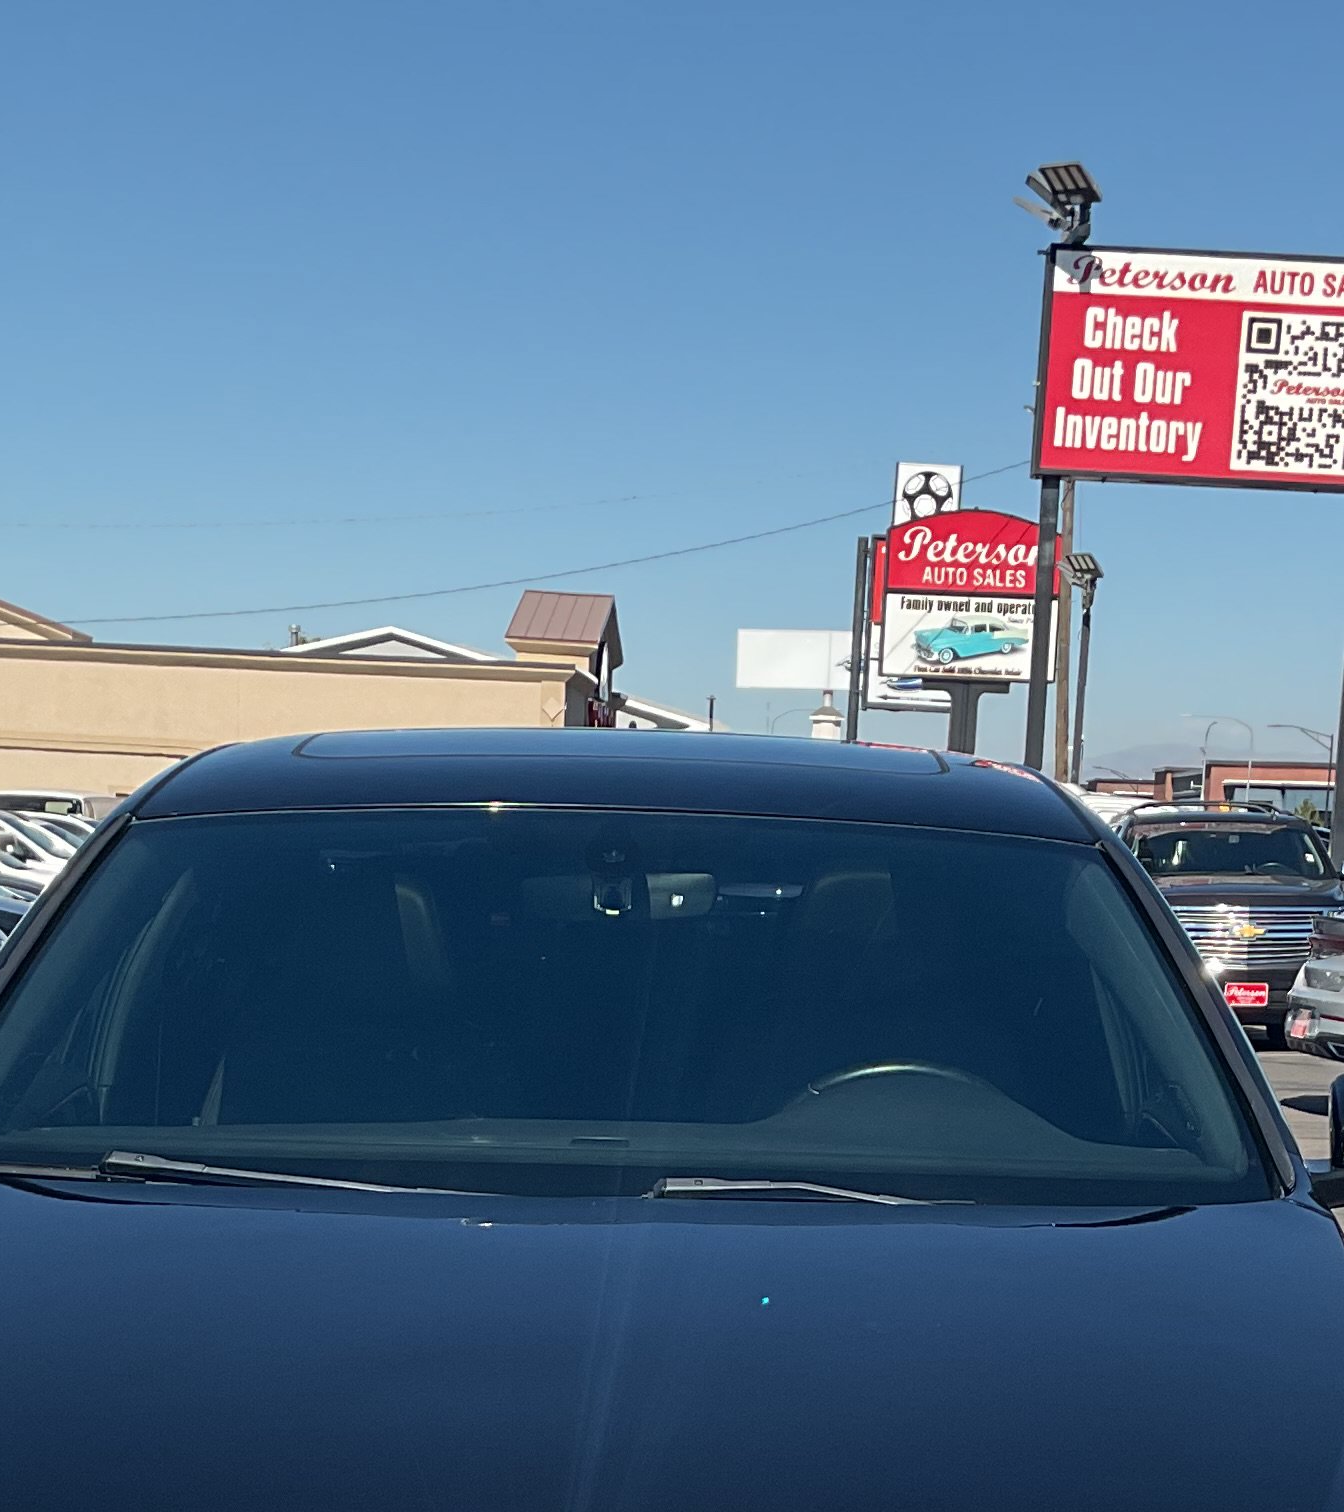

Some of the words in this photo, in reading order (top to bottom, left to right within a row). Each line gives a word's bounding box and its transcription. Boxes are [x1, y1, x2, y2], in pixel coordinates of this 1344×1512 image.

[1067, 255, 1236, 294] Peterson
[1253, 270, 1314, 296] AUTO
[1084, 306, 1179, 352] Check
[1071, 358, 1124, 400] Out
[1133, 362, 1192, 404] Our
[1053, 406, 1203, 461] Inventory
[922, 567, 967, 585] AUTO
[972, 569, 1026, 588] SALES
[901, 596, 934, 613] Family
[937, 598, 971, 612] owned
[974, 600, 993, 613] and
[997, 602, 1036, 616] operat
